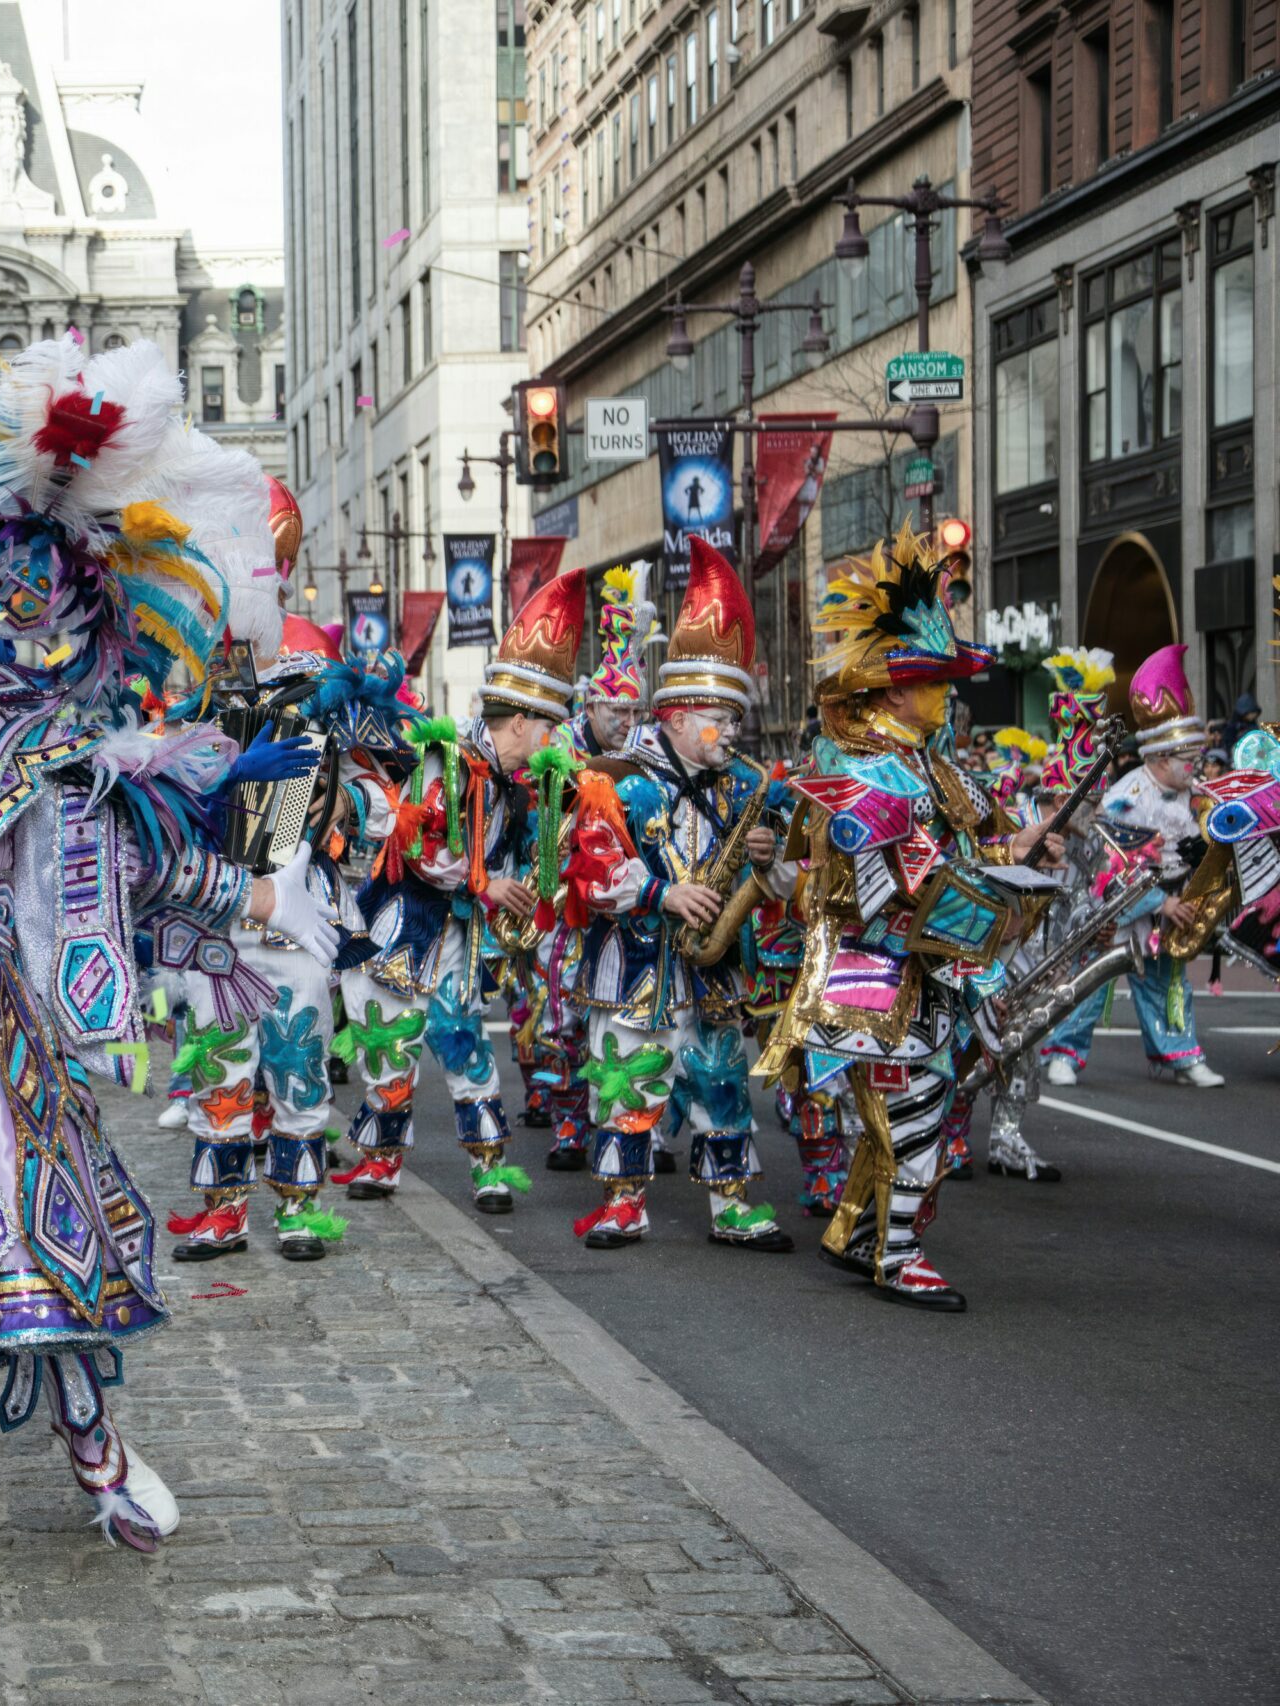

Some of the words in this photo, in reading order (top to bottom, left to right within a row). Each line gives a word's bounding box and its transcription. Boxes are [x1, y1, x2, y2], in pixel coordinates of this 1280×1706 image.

[889, 362, 947, 379] SANSOM
[951, 364, 963, 376] ST
[910, 384, 931, 396] ONE
[935, 383, 956, 395] WAY
[603, 407, 630, 426] NO
[590, 434, 644, 450] TURNS
[668, 431, 724, 446] HOLIDAY
